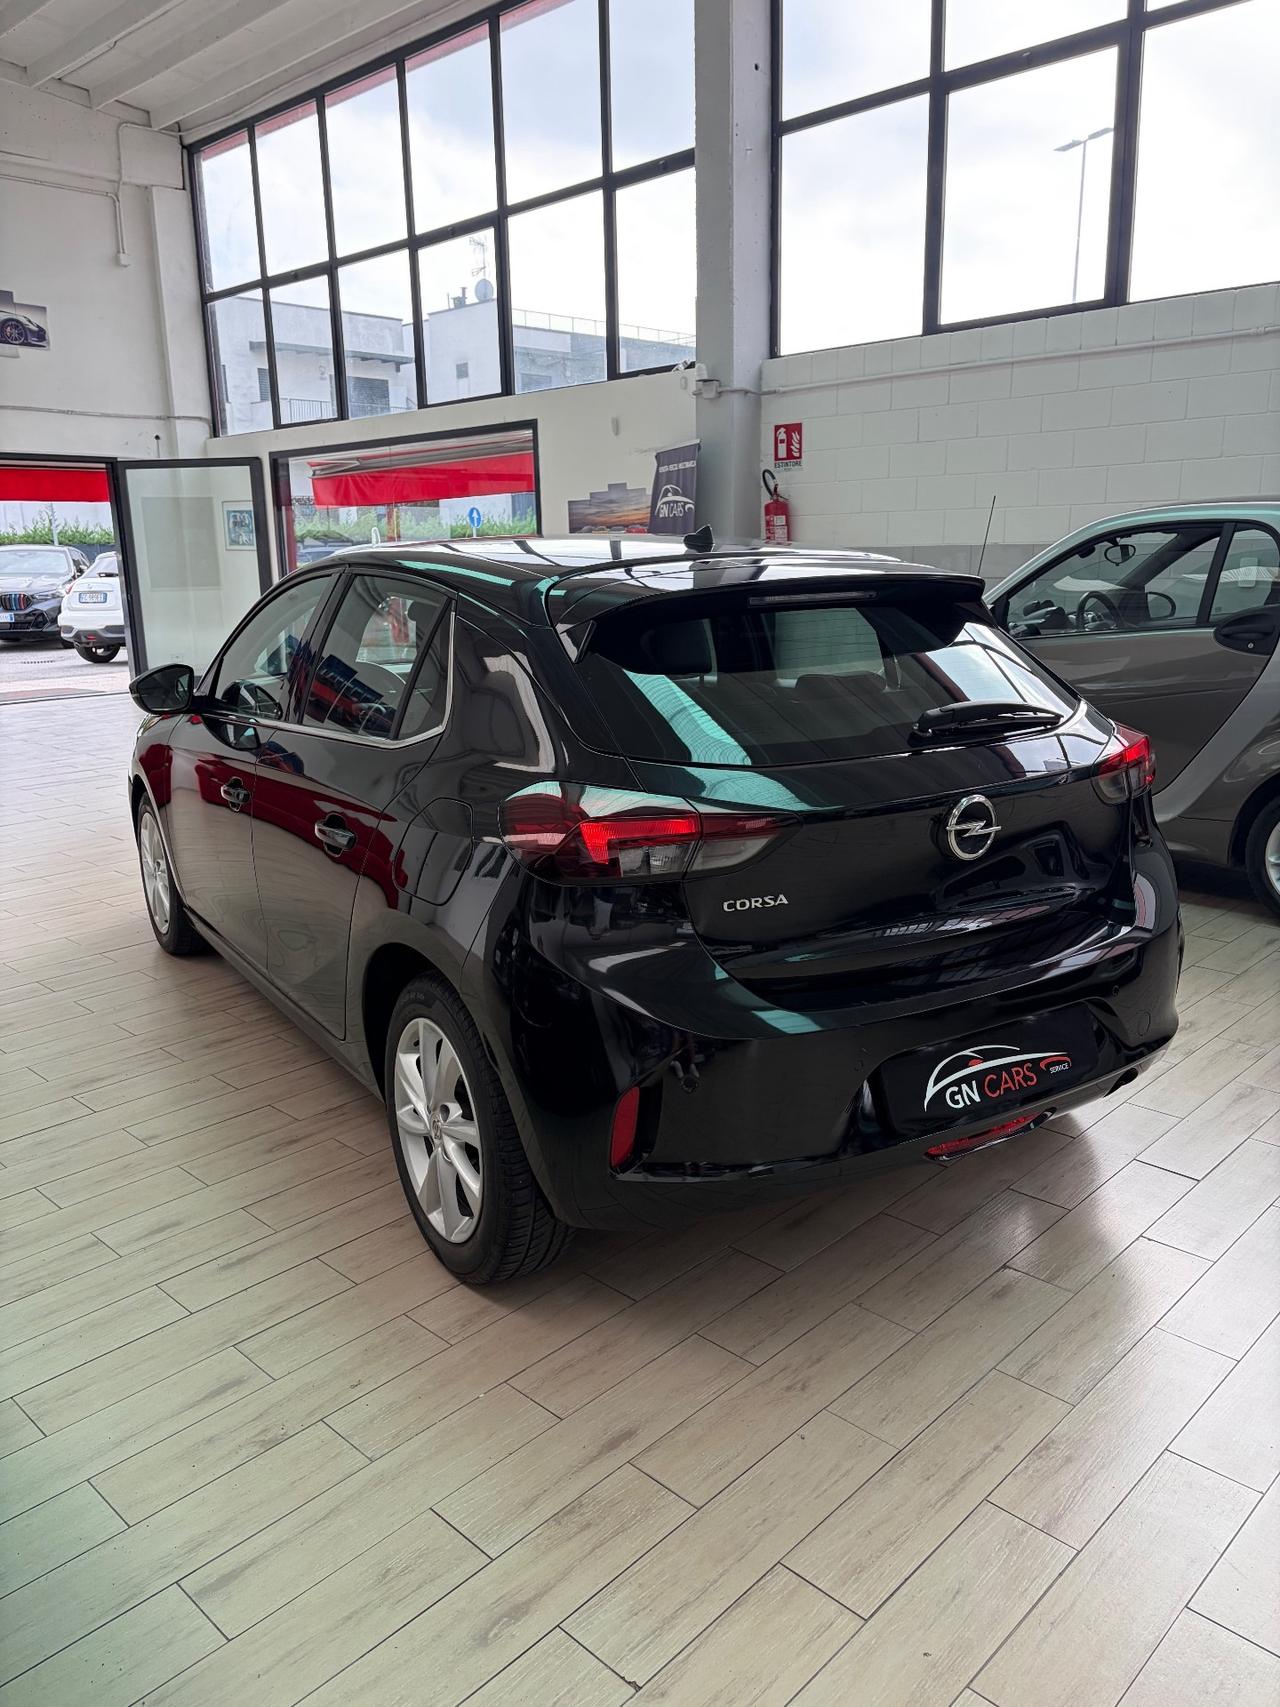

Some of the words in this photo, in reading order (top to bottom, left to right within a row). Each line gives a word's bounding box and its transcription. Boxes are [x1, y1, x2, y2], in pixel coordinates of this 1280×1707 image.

[774, 460, 802, 468] ESTINTORE
[723, 894, 788, 912] CORSA
[945, 1080, 981, 1109] GN
[984, 1063, 1037, 1098] CARS
[1050, 1063, 1069, 1073] SERVICE
